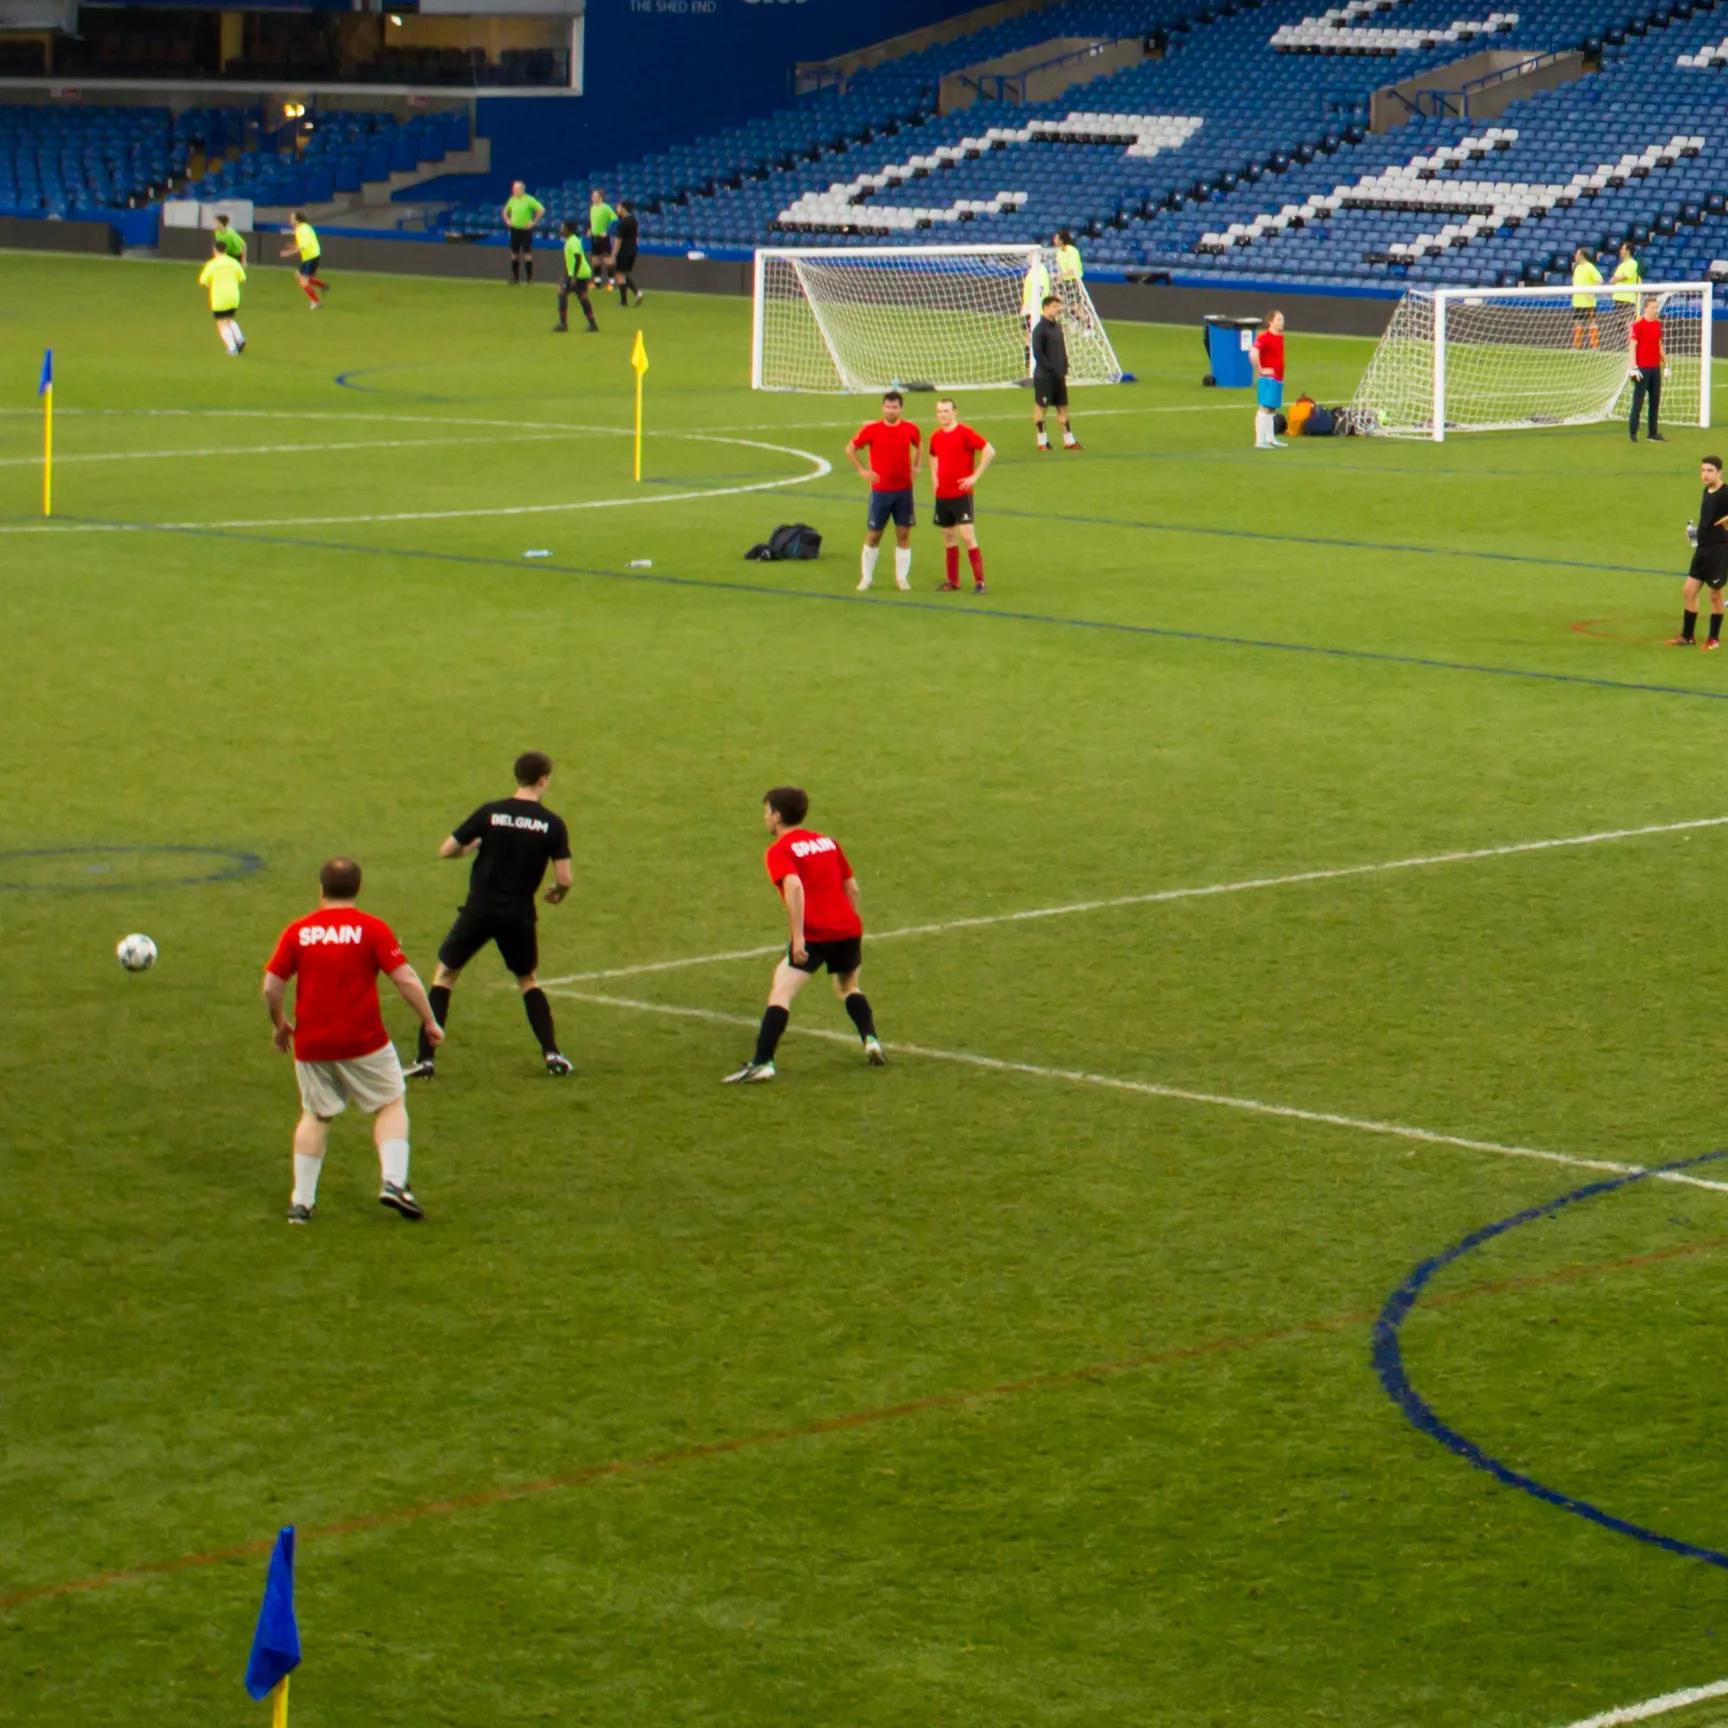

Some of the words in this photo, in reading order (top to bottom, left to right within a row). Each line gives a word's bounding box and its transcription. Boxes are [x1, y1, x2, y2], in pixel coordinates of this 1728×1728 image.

[692, 0, 716, 13] END
[490, 813, 549, 833] BELGIUM
[791, 836, 837, 857] SPAIN
[299, 925, 363, 947] SPAIN
